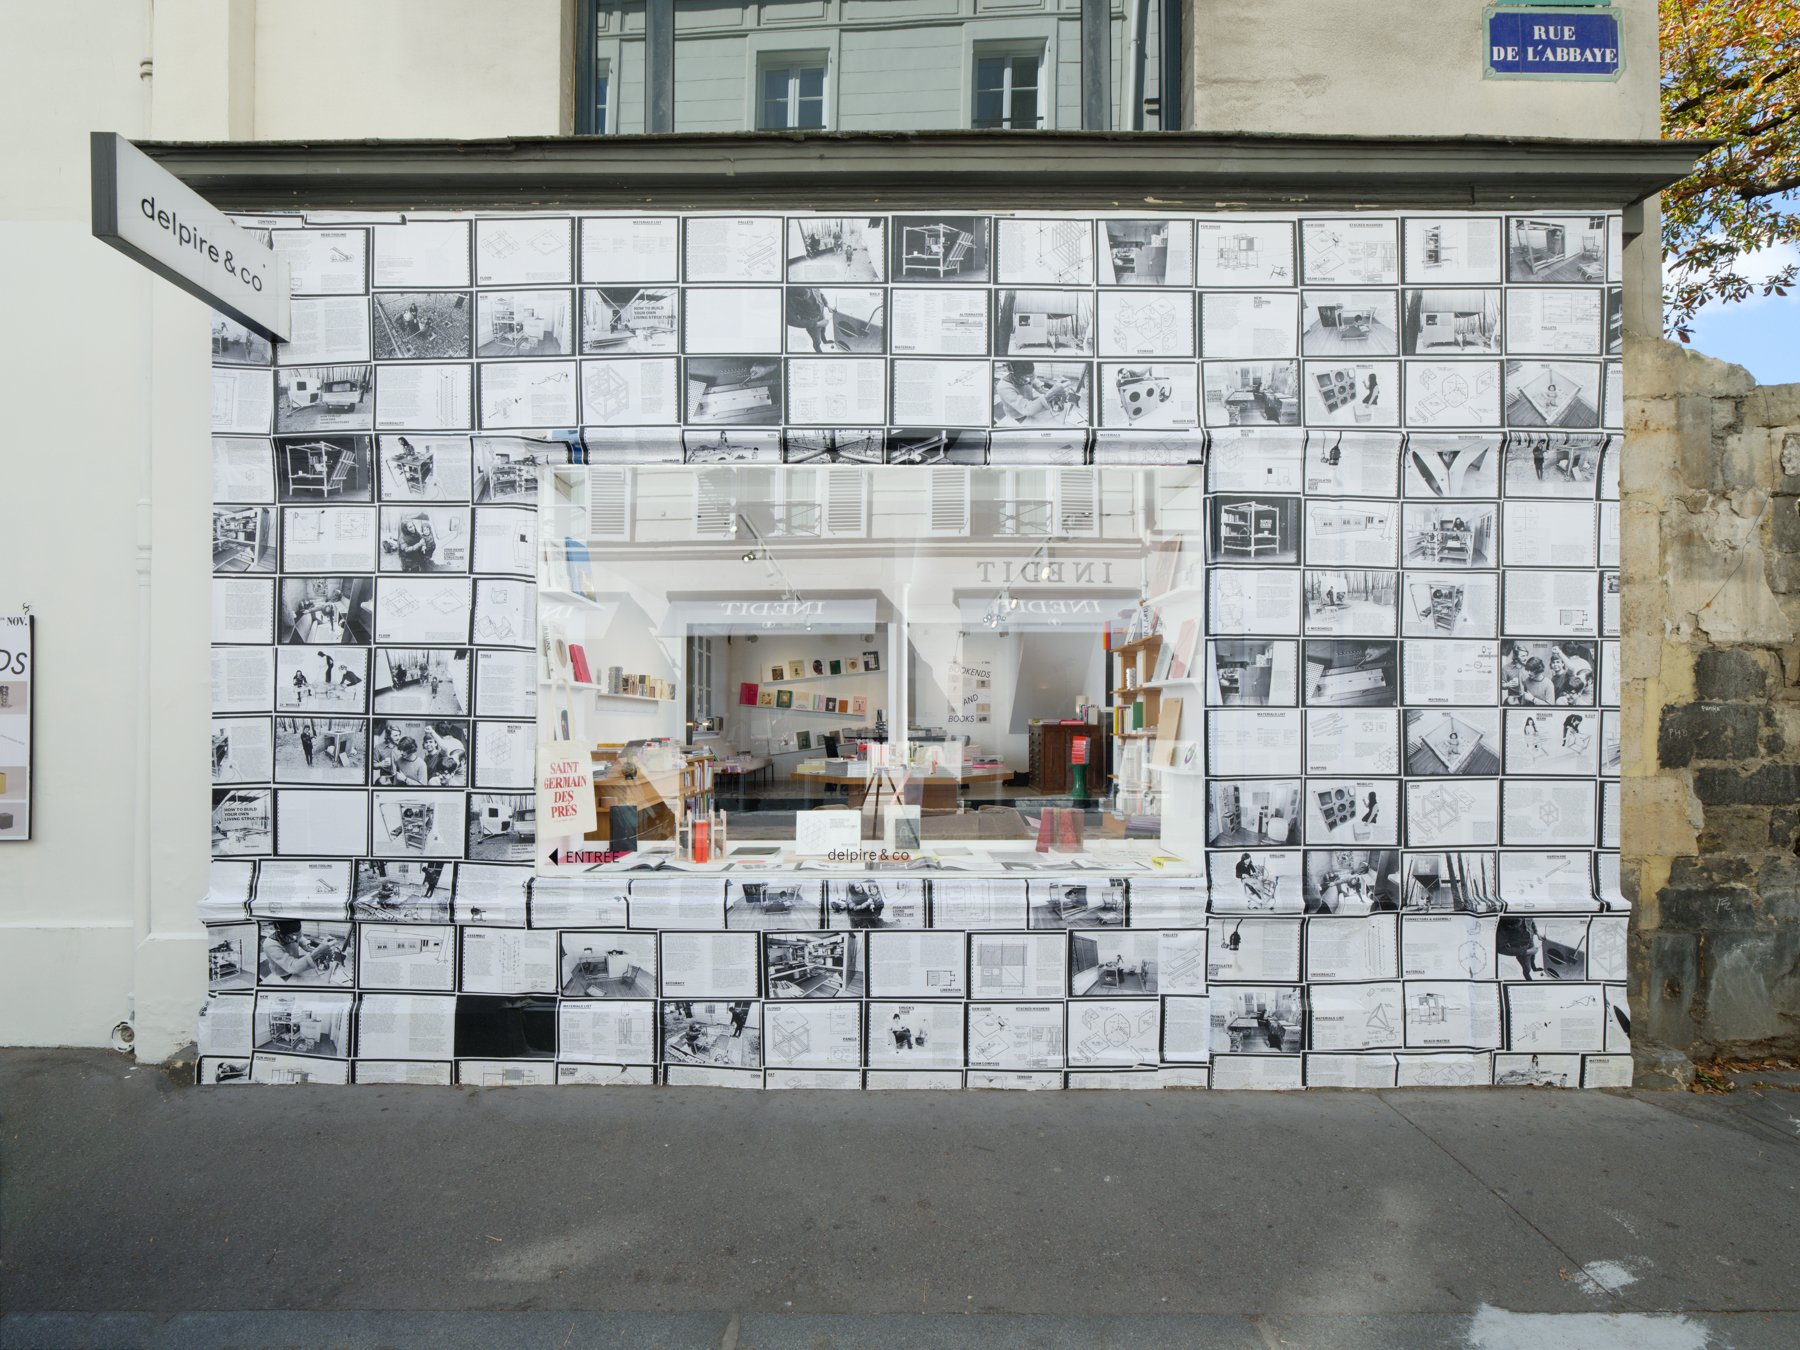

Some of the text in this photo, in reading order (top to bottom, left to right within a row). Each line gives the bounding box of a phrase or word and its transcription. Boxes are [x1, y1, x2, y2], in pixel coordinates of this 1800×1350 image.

[1533, 25, 1576, 41] RUE
[1492, 44, 1618, 63] DE L'ABBAYE
[141, 196, 262, 292] delpire & co
[6, 617, 28, 627] NOV.
[948, 665, 991, 679] BOOKENDS
[963, 694, 979, 706] AND
[947, 715, 975, 723] BOOKS
[550, 762, 579, 775] SAINT
[544, 775, 587, 790] GERMAIN
[553, 790, 574, 804] DES
[551, 800, 578, 819] PRÉS
[566, 848, 620, 864] ENTRÉE
[827, 848, 910, 863] delpire & co
